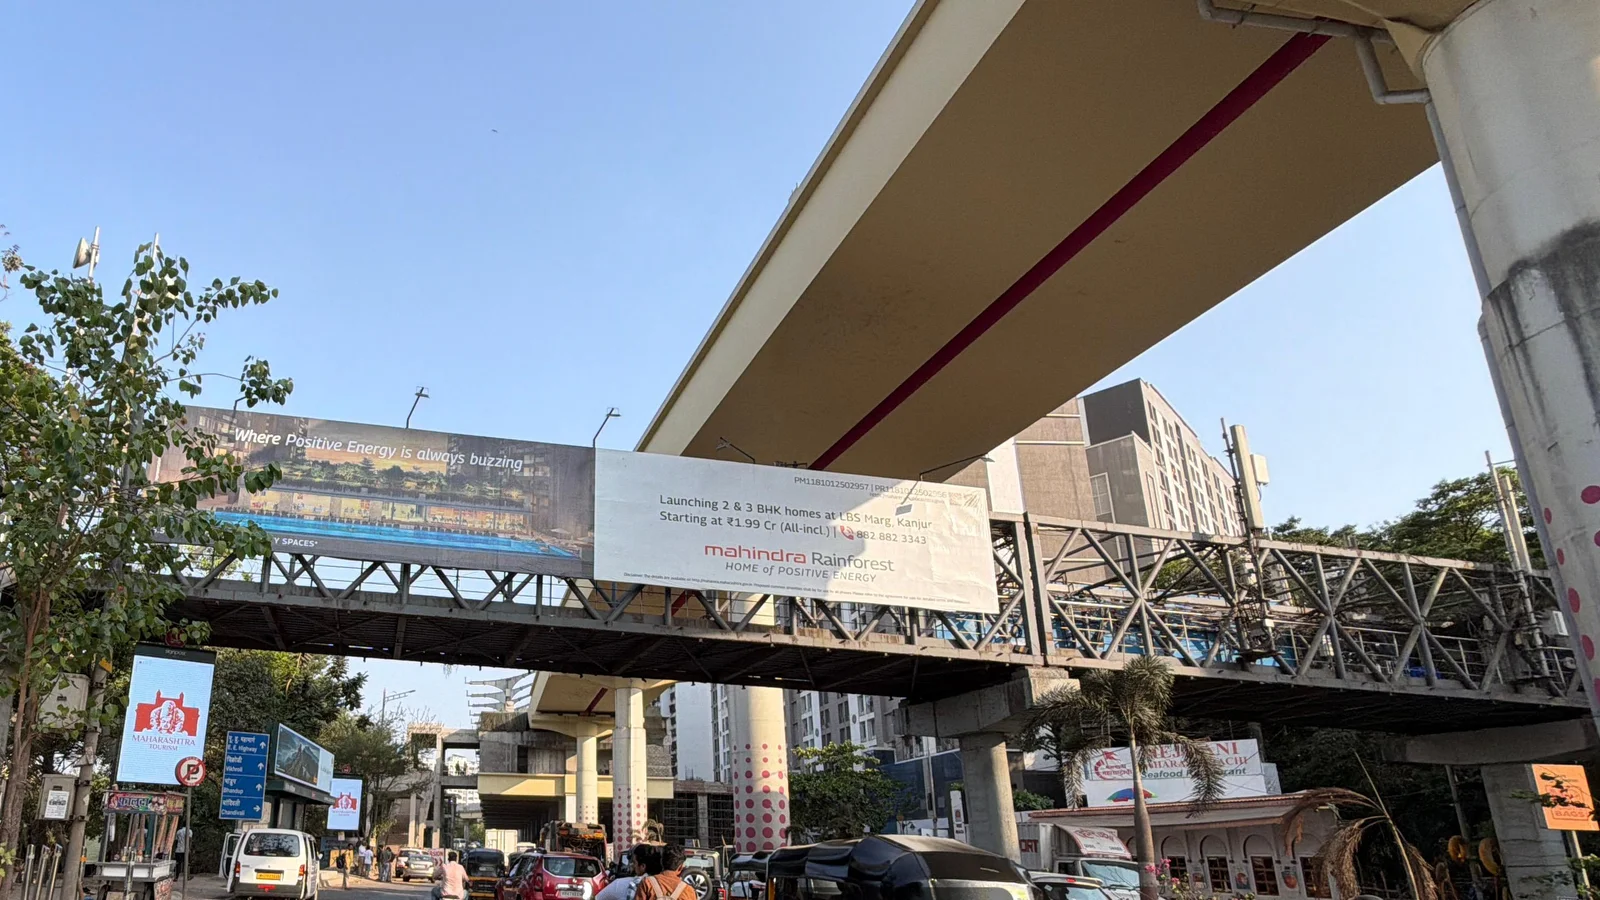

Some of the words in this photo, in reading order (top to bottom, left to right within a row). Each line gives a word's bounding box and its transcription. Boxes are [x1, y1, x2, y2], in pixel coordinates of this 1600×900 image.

[234, 428, 281, 445] Where
[285, 433, 342, 451] Positive
[346, 440, 397, 459] Energy
[400, 446, 413, 458] is
[416, 448, 465, 465] always
[469, 452, 523, 472] buzzing
[660, 495, 718, 511] Launching
[722, 500, 730, 510] 2
[733, 501, 742, 511] &
[745, 502, 753, 512] 3
[757, 504, 781, 515] BHK
[785, 506, 821, 519] homes
[824, 511, 836, 520] at
[840, 512, 861, 522] LBS
[864, 514, 894, 528] Marg,
[897, 517, 932, 529] Kanjur
[660, 511, 707, 526] Starting
[711, 516, 723, 526] at
[727, 517, 760, 528] ₹1.99
[764, 520, 776, 531] Cr
[780, 521, 830, 538] (All-incl.)
[856, 530, 876, 540] 882
[880, 532, 898, 542] 882
[901, 534, 927, 544] 3343
[704, 545, 806, 564] mahindra
[811, 552, 895, 571] Rainforest
[725, 562, 758, 572] HOME
[763, 565, 775, 576] of
[778, 567, 829, 579] POSITIVE
[833, 571, 877, 582] ENERGY
[132, 734, 196, 746] MAHARASHTRA
[238, 745, 257, 753] Highway
[1142, 769, 1183, 778] Seafood
[223, 787, 243, 795] Bhandup
[1019, 839, 1039, 853] ORT
